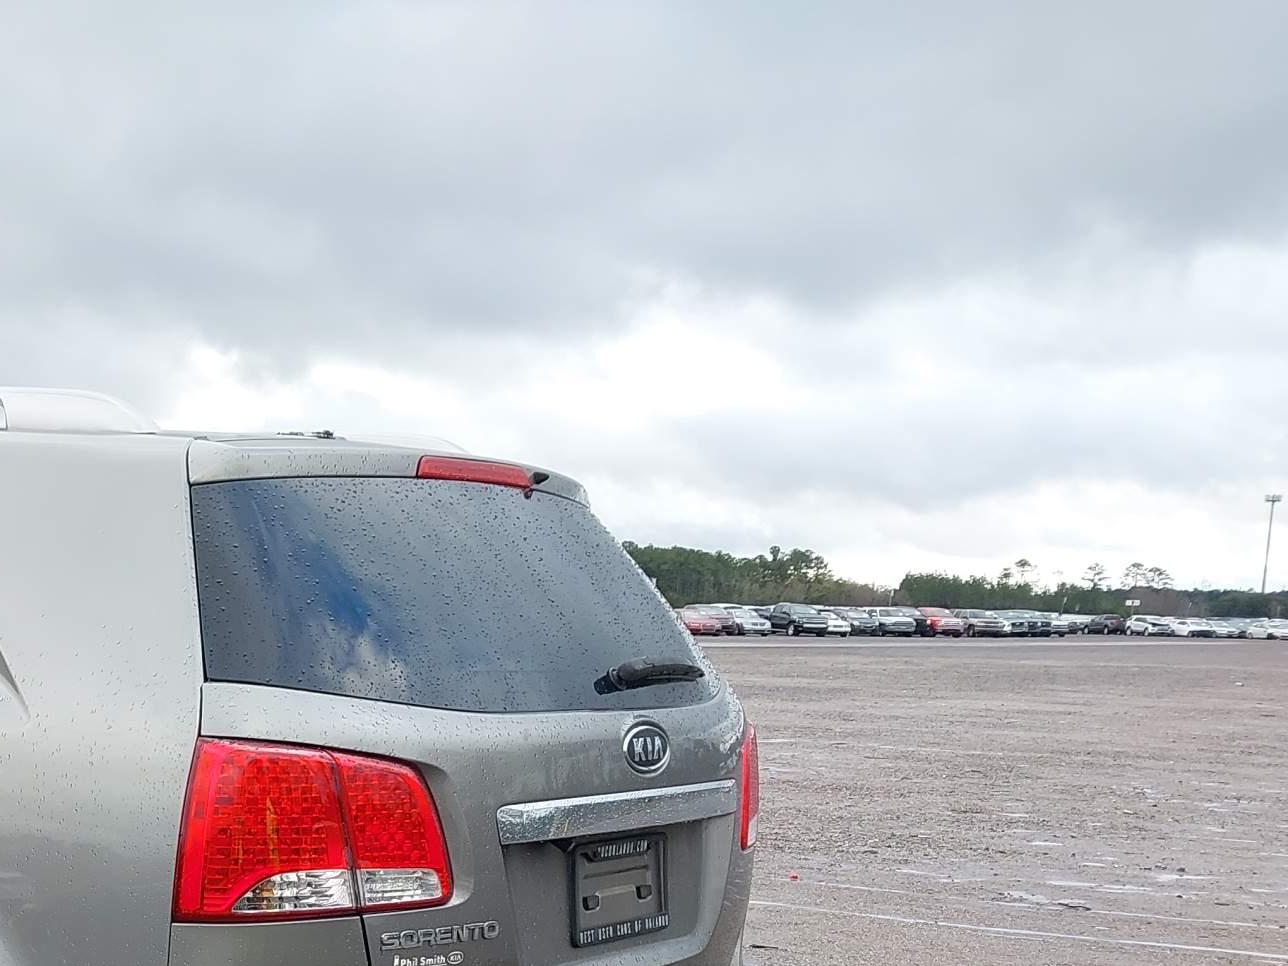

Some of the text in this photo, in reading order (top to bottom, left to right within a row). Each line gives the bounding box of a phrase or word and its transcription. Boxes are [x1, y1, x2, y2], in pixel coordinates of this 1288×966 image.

[633, 736, 663, 761] KIA
[380, 920, 499, 951] SORENTO
[579, 914, 669, 945] BEST USED CARS OF ORLANDO
[420, 954, 446, 966] Smith
